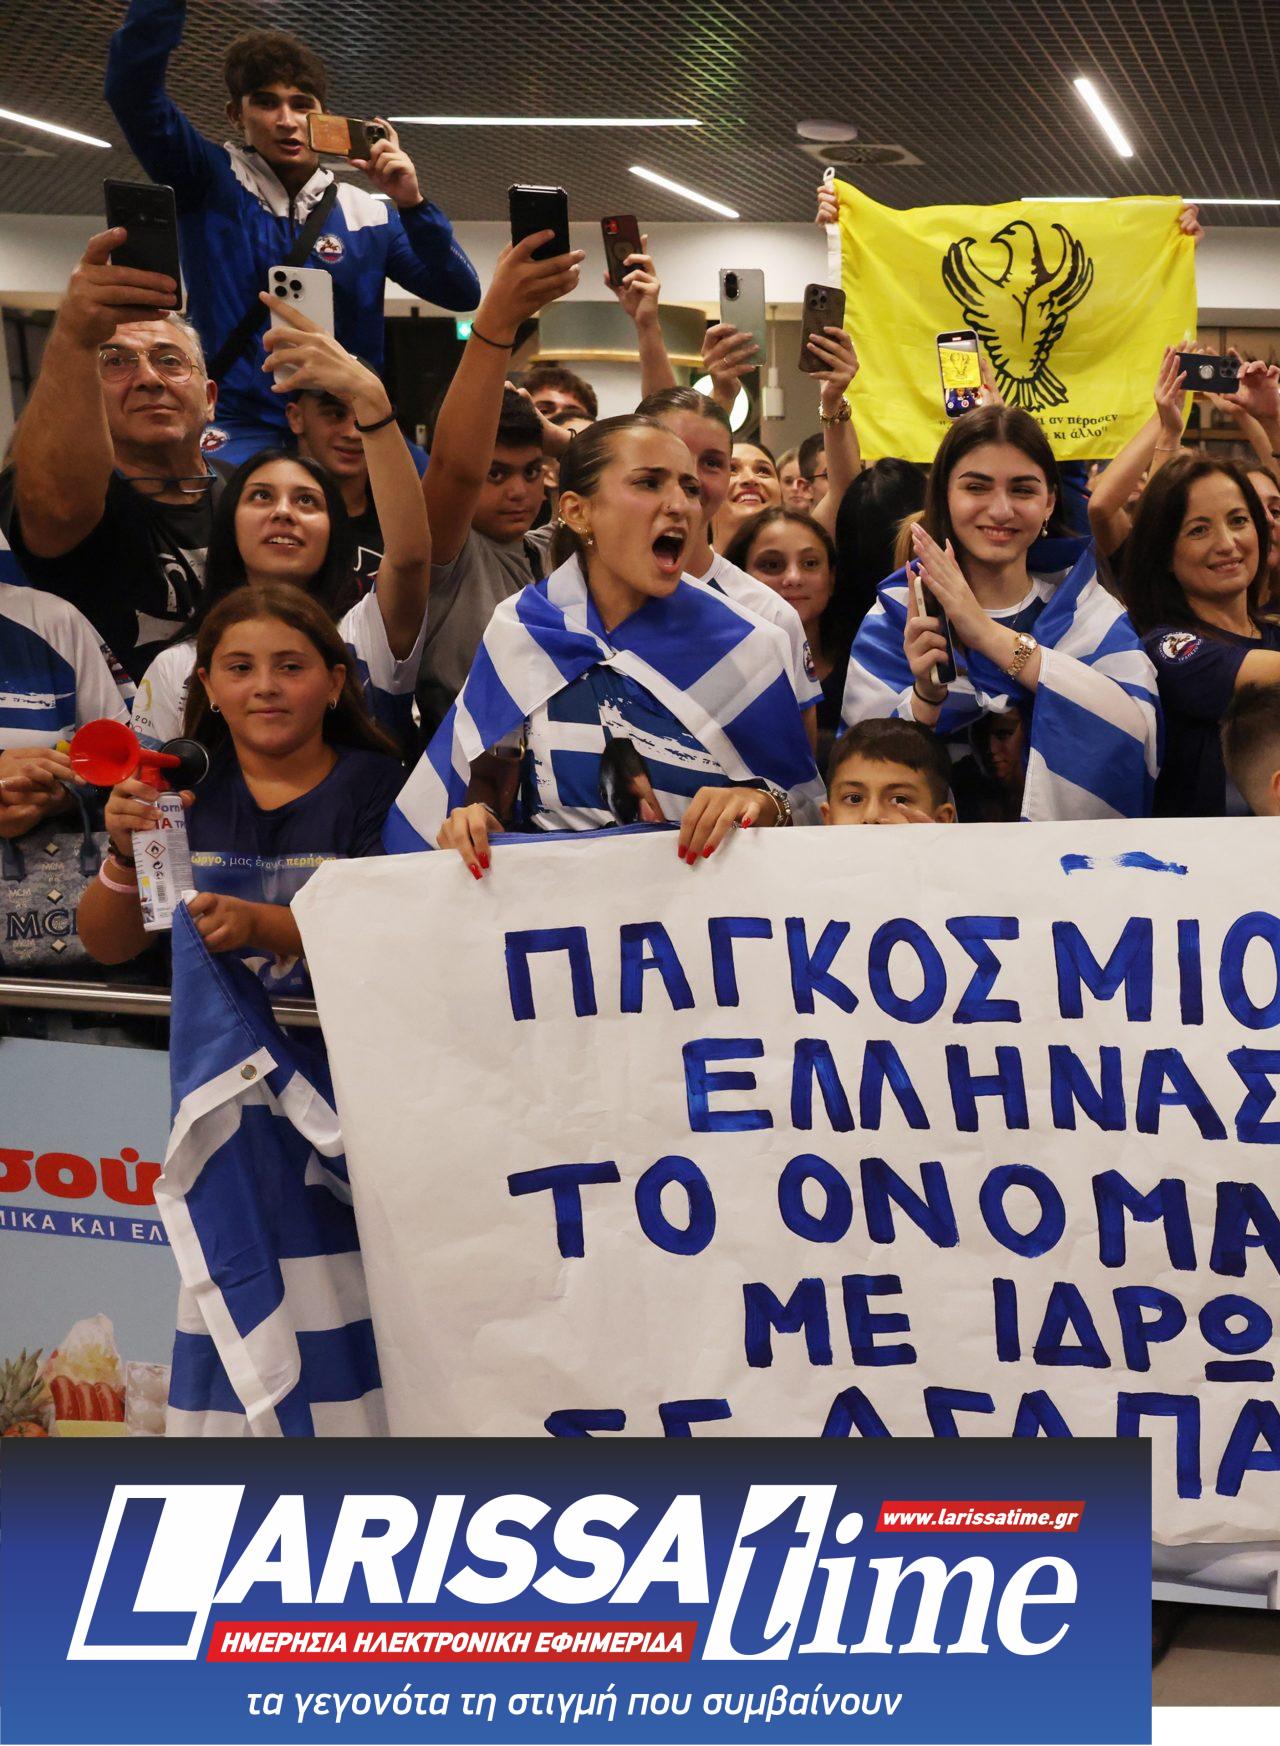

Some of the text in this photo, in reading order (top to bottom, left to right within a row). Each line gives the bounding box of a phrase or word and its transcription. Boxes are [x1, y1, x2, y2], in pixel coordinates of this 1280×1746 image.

[229, 857, 252, 868] μας
[71, 1217, 116, 1237] ΚΑΙ
[132, 1223, 171, 1242] ΕΛ
[507, 1154, 717, 1259] ΤΟ
[742, 1273, 918, 1368] ΜΕ
